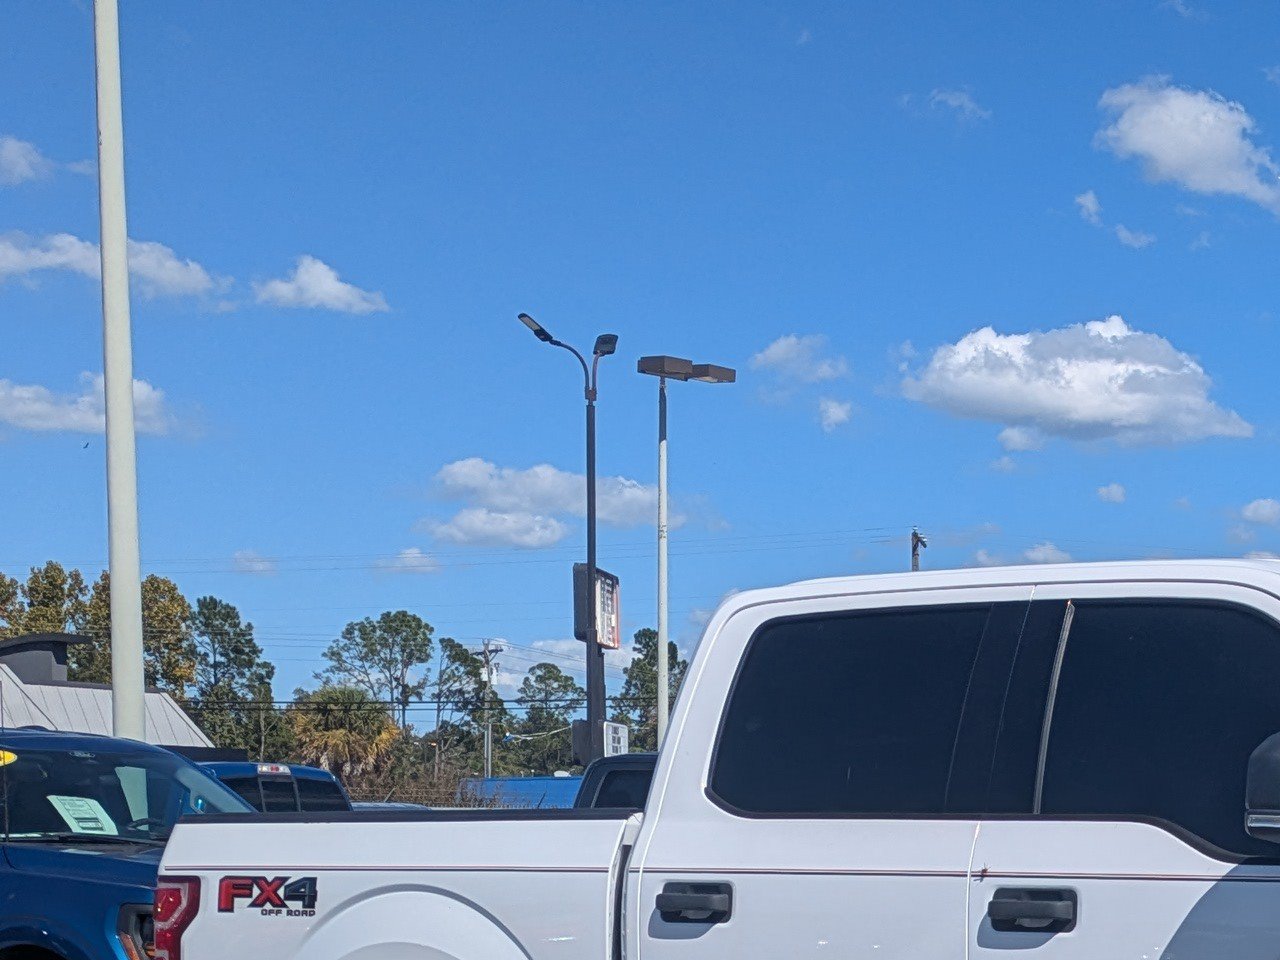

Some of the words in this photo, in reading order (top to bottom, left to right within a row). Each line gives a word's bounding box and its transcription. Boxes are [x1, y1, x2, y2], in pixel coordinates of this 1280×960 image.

[217, 875, 318, 913] FX4
[260, 908, 283, 917] OFF
[286, 908, 316, 917] ROAD
